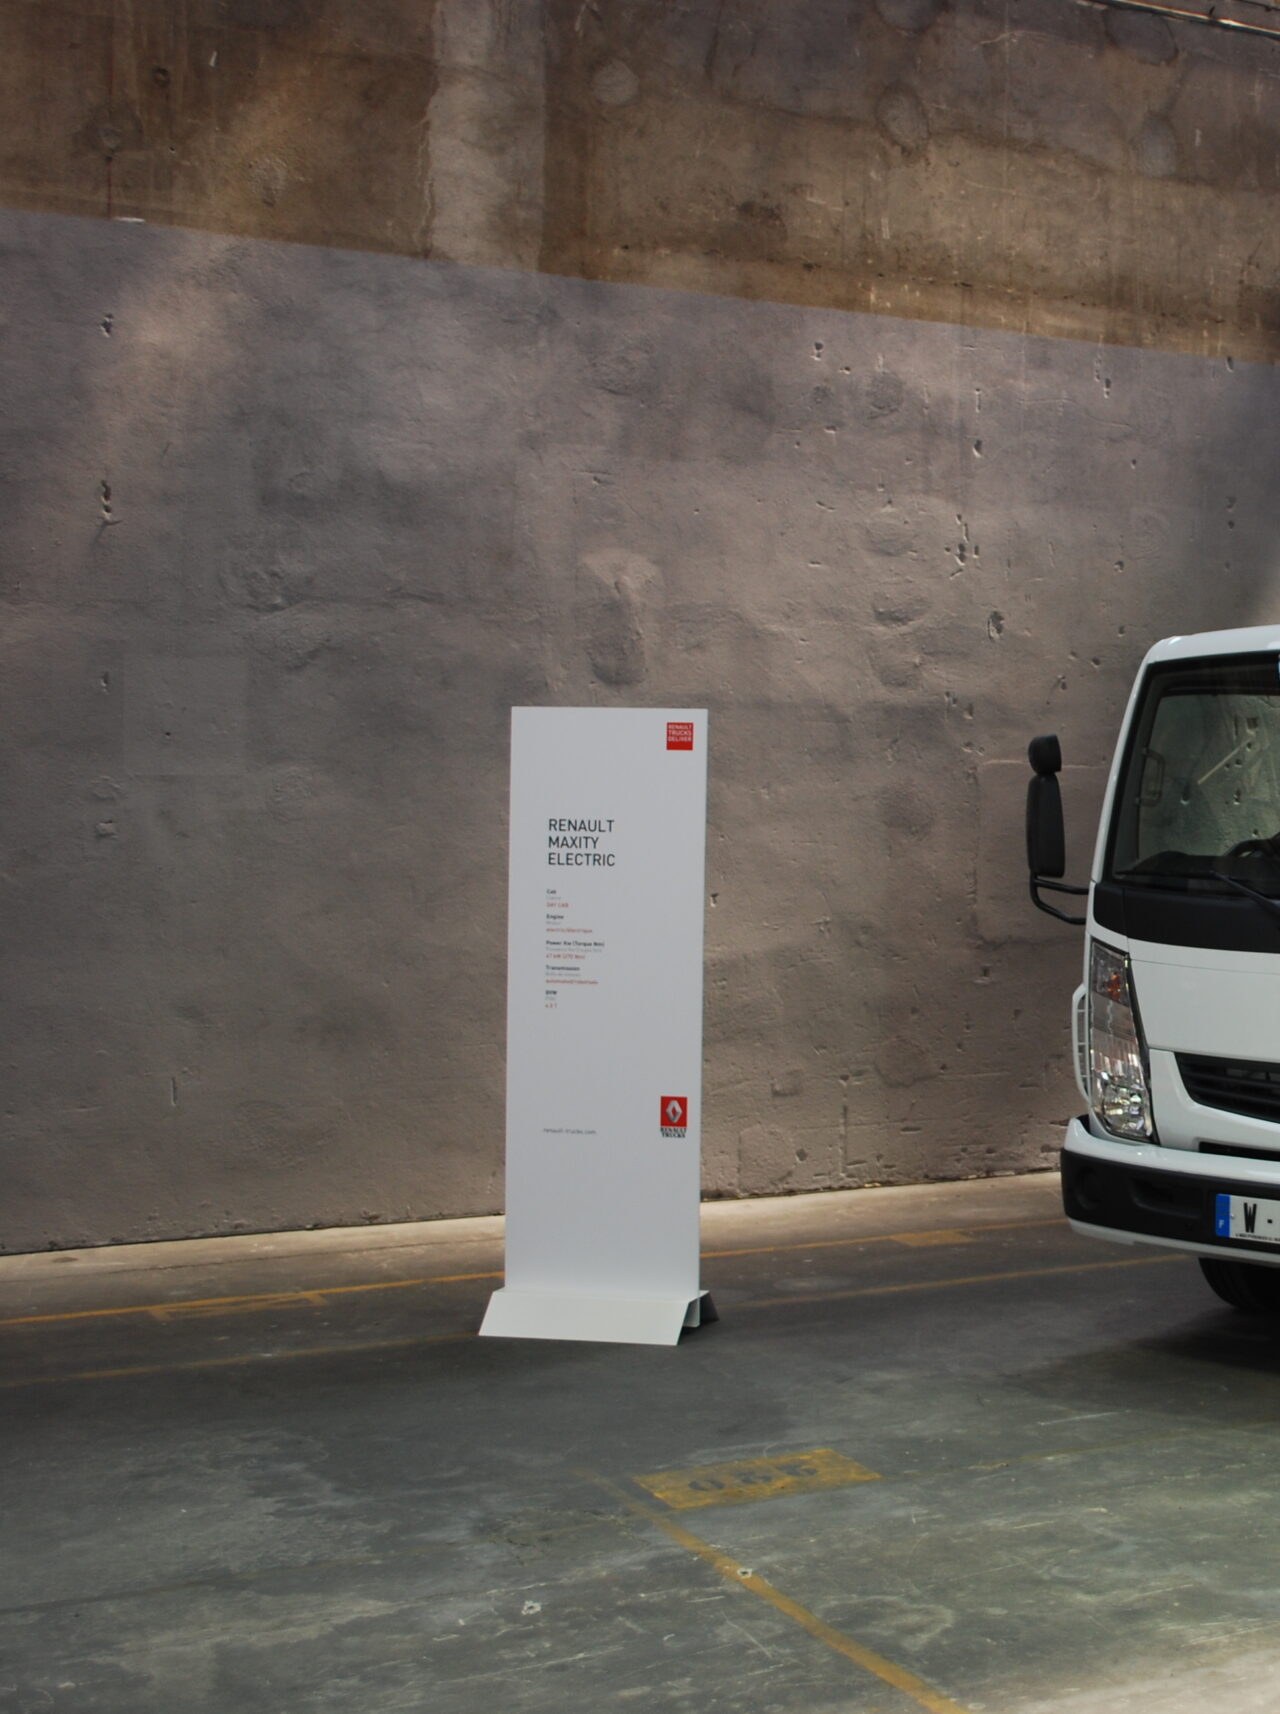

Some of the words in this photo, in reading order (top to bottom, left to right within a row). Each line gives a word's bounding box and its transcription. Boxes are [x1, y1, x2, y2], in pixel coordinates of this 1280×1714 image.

[548, 818, 615, 833] RENAULT
[548, 835, 600, 849] MAXITY
[547, 852, 616, 867] ELECTRIC
[1218, 1219, 1225, 1229] F
[1243, 1202, 1257, 1234] W
